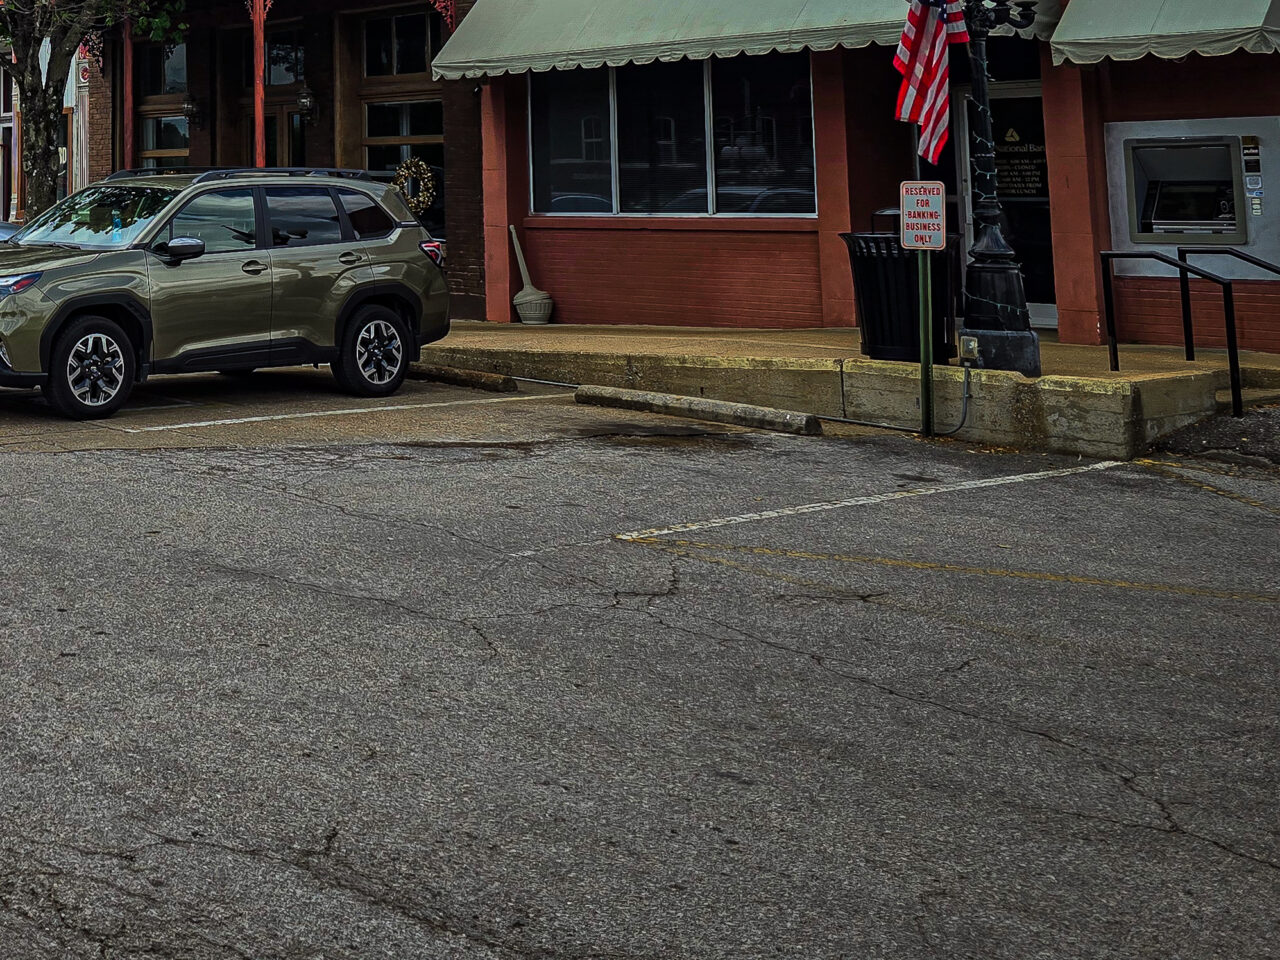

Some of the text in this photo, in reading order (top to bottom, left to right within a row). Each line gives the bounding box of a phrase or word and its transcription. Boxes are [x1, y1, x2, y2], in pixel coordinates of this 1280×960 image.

[905, 187, 941, 196] RESERVED
[916, 199, 930, 208] FOR
[905, 222, 942, 232] BUSINESS
[914, 234, 933, 243] ONLY
